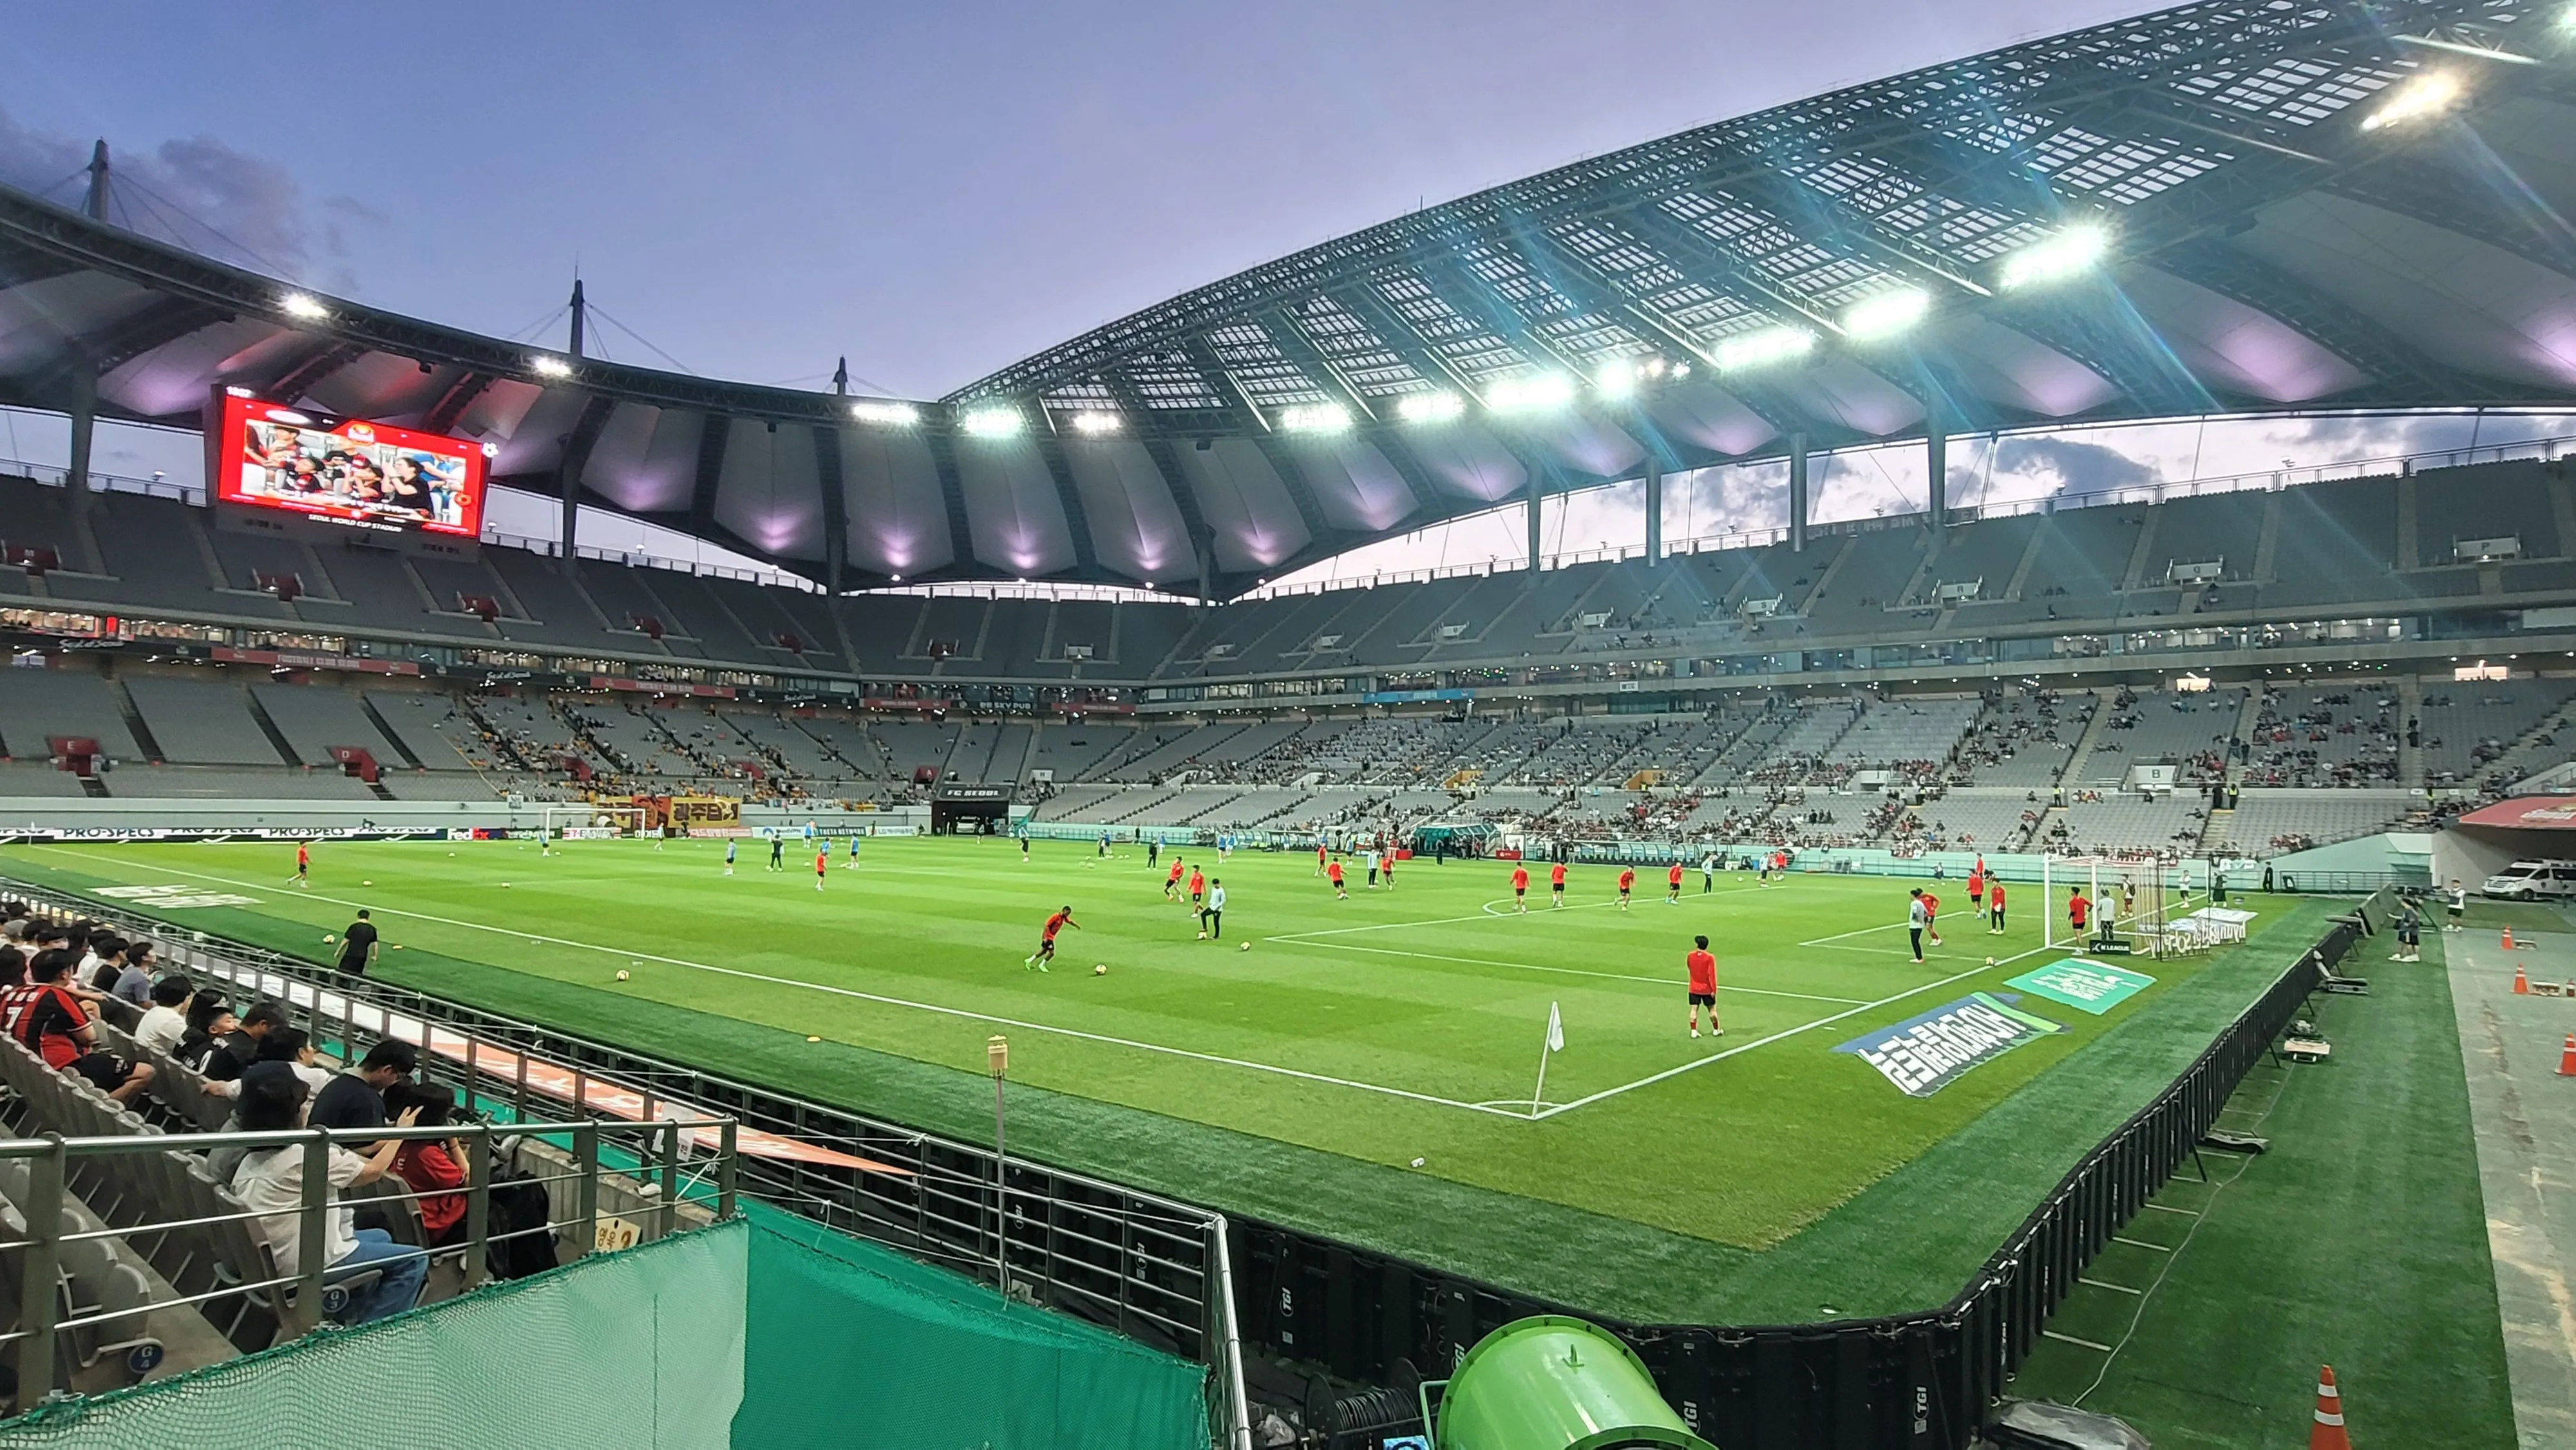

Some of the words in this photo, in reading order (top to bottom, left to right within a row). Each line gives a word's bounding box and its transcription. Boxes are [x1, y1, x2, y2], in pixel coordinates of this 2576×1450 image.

[2481, 542, 2491, 551] P
[66, 741, 75, 750] E
[2152, 769, 2161, 778] B
[64, 827, 155, 837] PRO-SPECS
[269, 827, 345, 836] PRO-SPECS
[448, 827, 489, 840] FedEx
[1857, 1003, 2027, 1095] HD현대일렉트릭
[141, 1348, 153, 1358] G
[140, 1359, 150, 1368] 4
[1916, 1386, 1927, 1413] TGI
[1683, 1400, 1698, 1428] TGI
